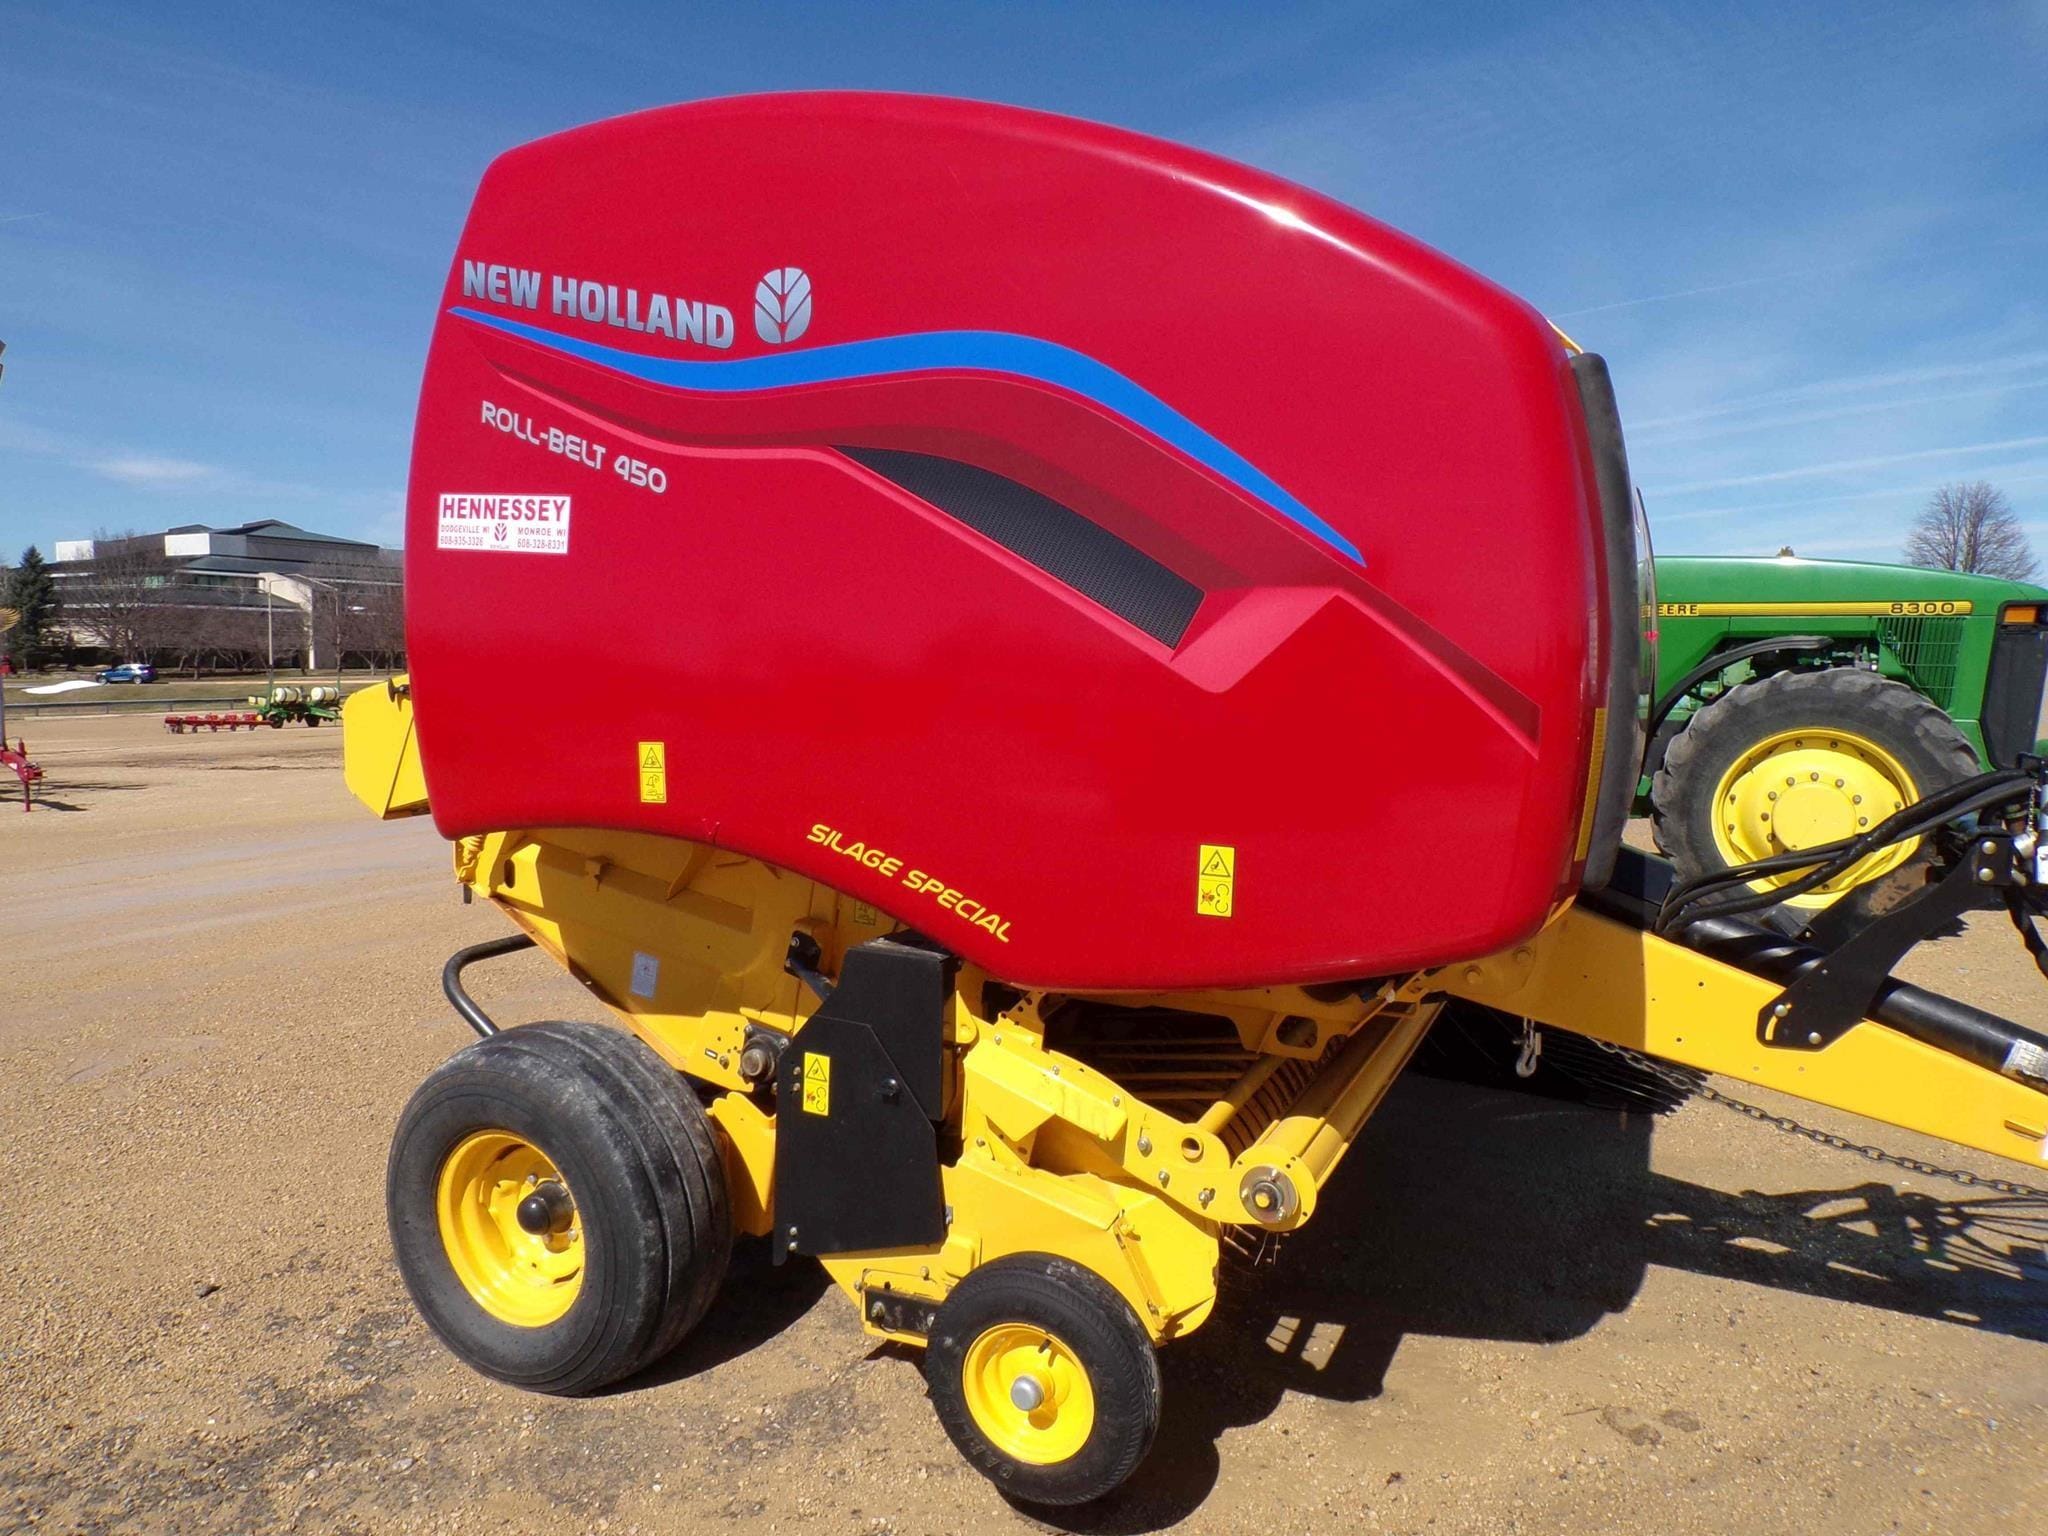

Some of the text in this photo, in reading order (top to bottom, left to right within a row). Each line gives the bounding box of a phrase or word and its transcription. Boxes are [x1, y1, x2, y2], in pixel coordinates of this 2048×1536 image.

[463, 259, 735, 350] NEW HOLLAND
[481, 400, 668, 494] ROLL-BELT 450
[442, 497, 567, 522] HENNESSEY
[440, 524, 480, 533] DODGEVILLE
[518, 527, 566, 537] MONROE WI
[1656, 604, 1698, 615] EERE
[1889, 601, 1956, 615] 8300
[806, 823, 1012, 944] SILAGE SPECIAL
